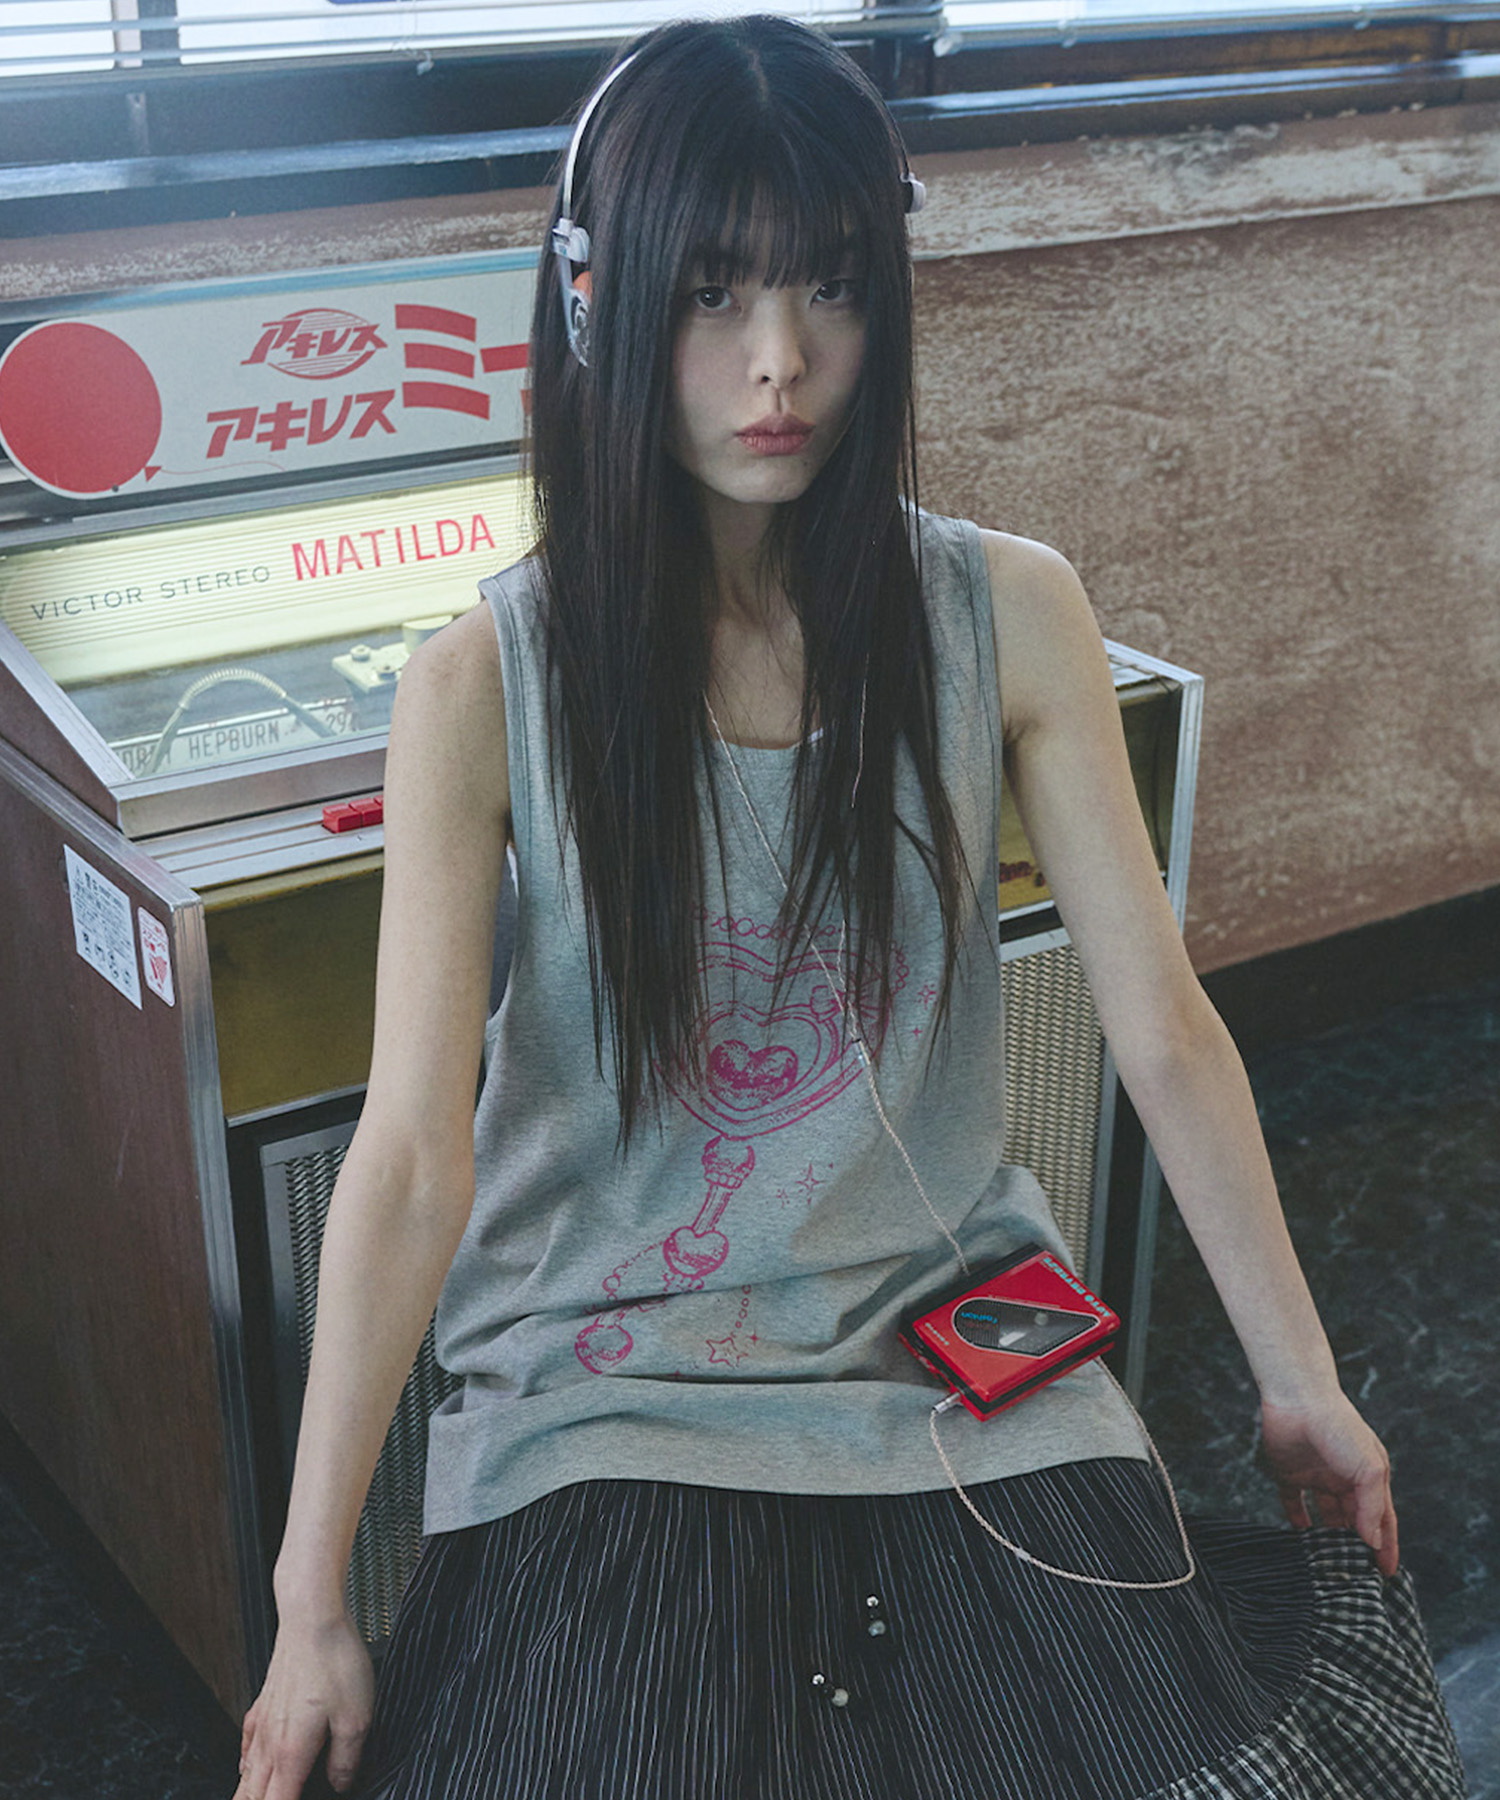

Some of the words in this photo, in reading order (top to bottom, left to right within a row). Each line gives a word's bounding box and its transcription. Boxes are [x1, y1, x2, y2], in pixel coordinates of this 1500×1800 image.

[240, 318, 389, 366] アキレス
[206, 388, 398, 460] アキレス
[292, 513, 496, 581] MATILDA
[31, 586, 143, 620] VICTOR
[160, 565, 271, 600] STEREO
[188, 719, 280, 760] HEPBURN
